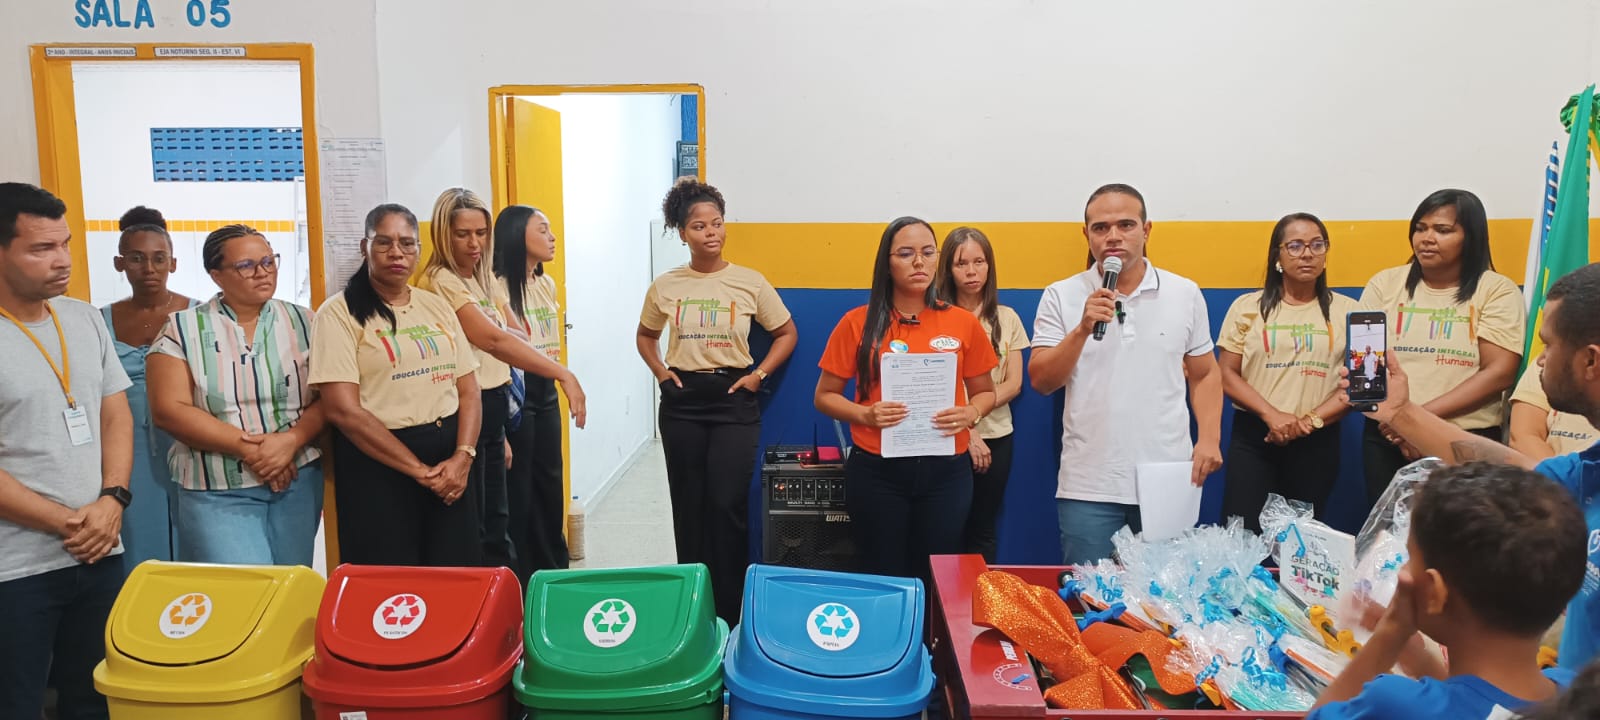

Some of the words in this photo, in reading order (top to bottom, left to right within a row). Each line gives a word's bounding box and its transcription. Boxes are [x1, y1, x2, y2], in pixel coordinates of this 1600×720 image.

[74, 0, 155, 29] SALA
[186, 0, 232, 28] 05
[1393, 346, 1436, 354] EDUCAÇÃO
[1437, 348, 1476, 358] INTEGRAL
[1435, 354, 1474, 367] Humana
[391, 367, 430, 381] EDUCAÇÃO
[1290, 565, 1340, 591] TikTok
